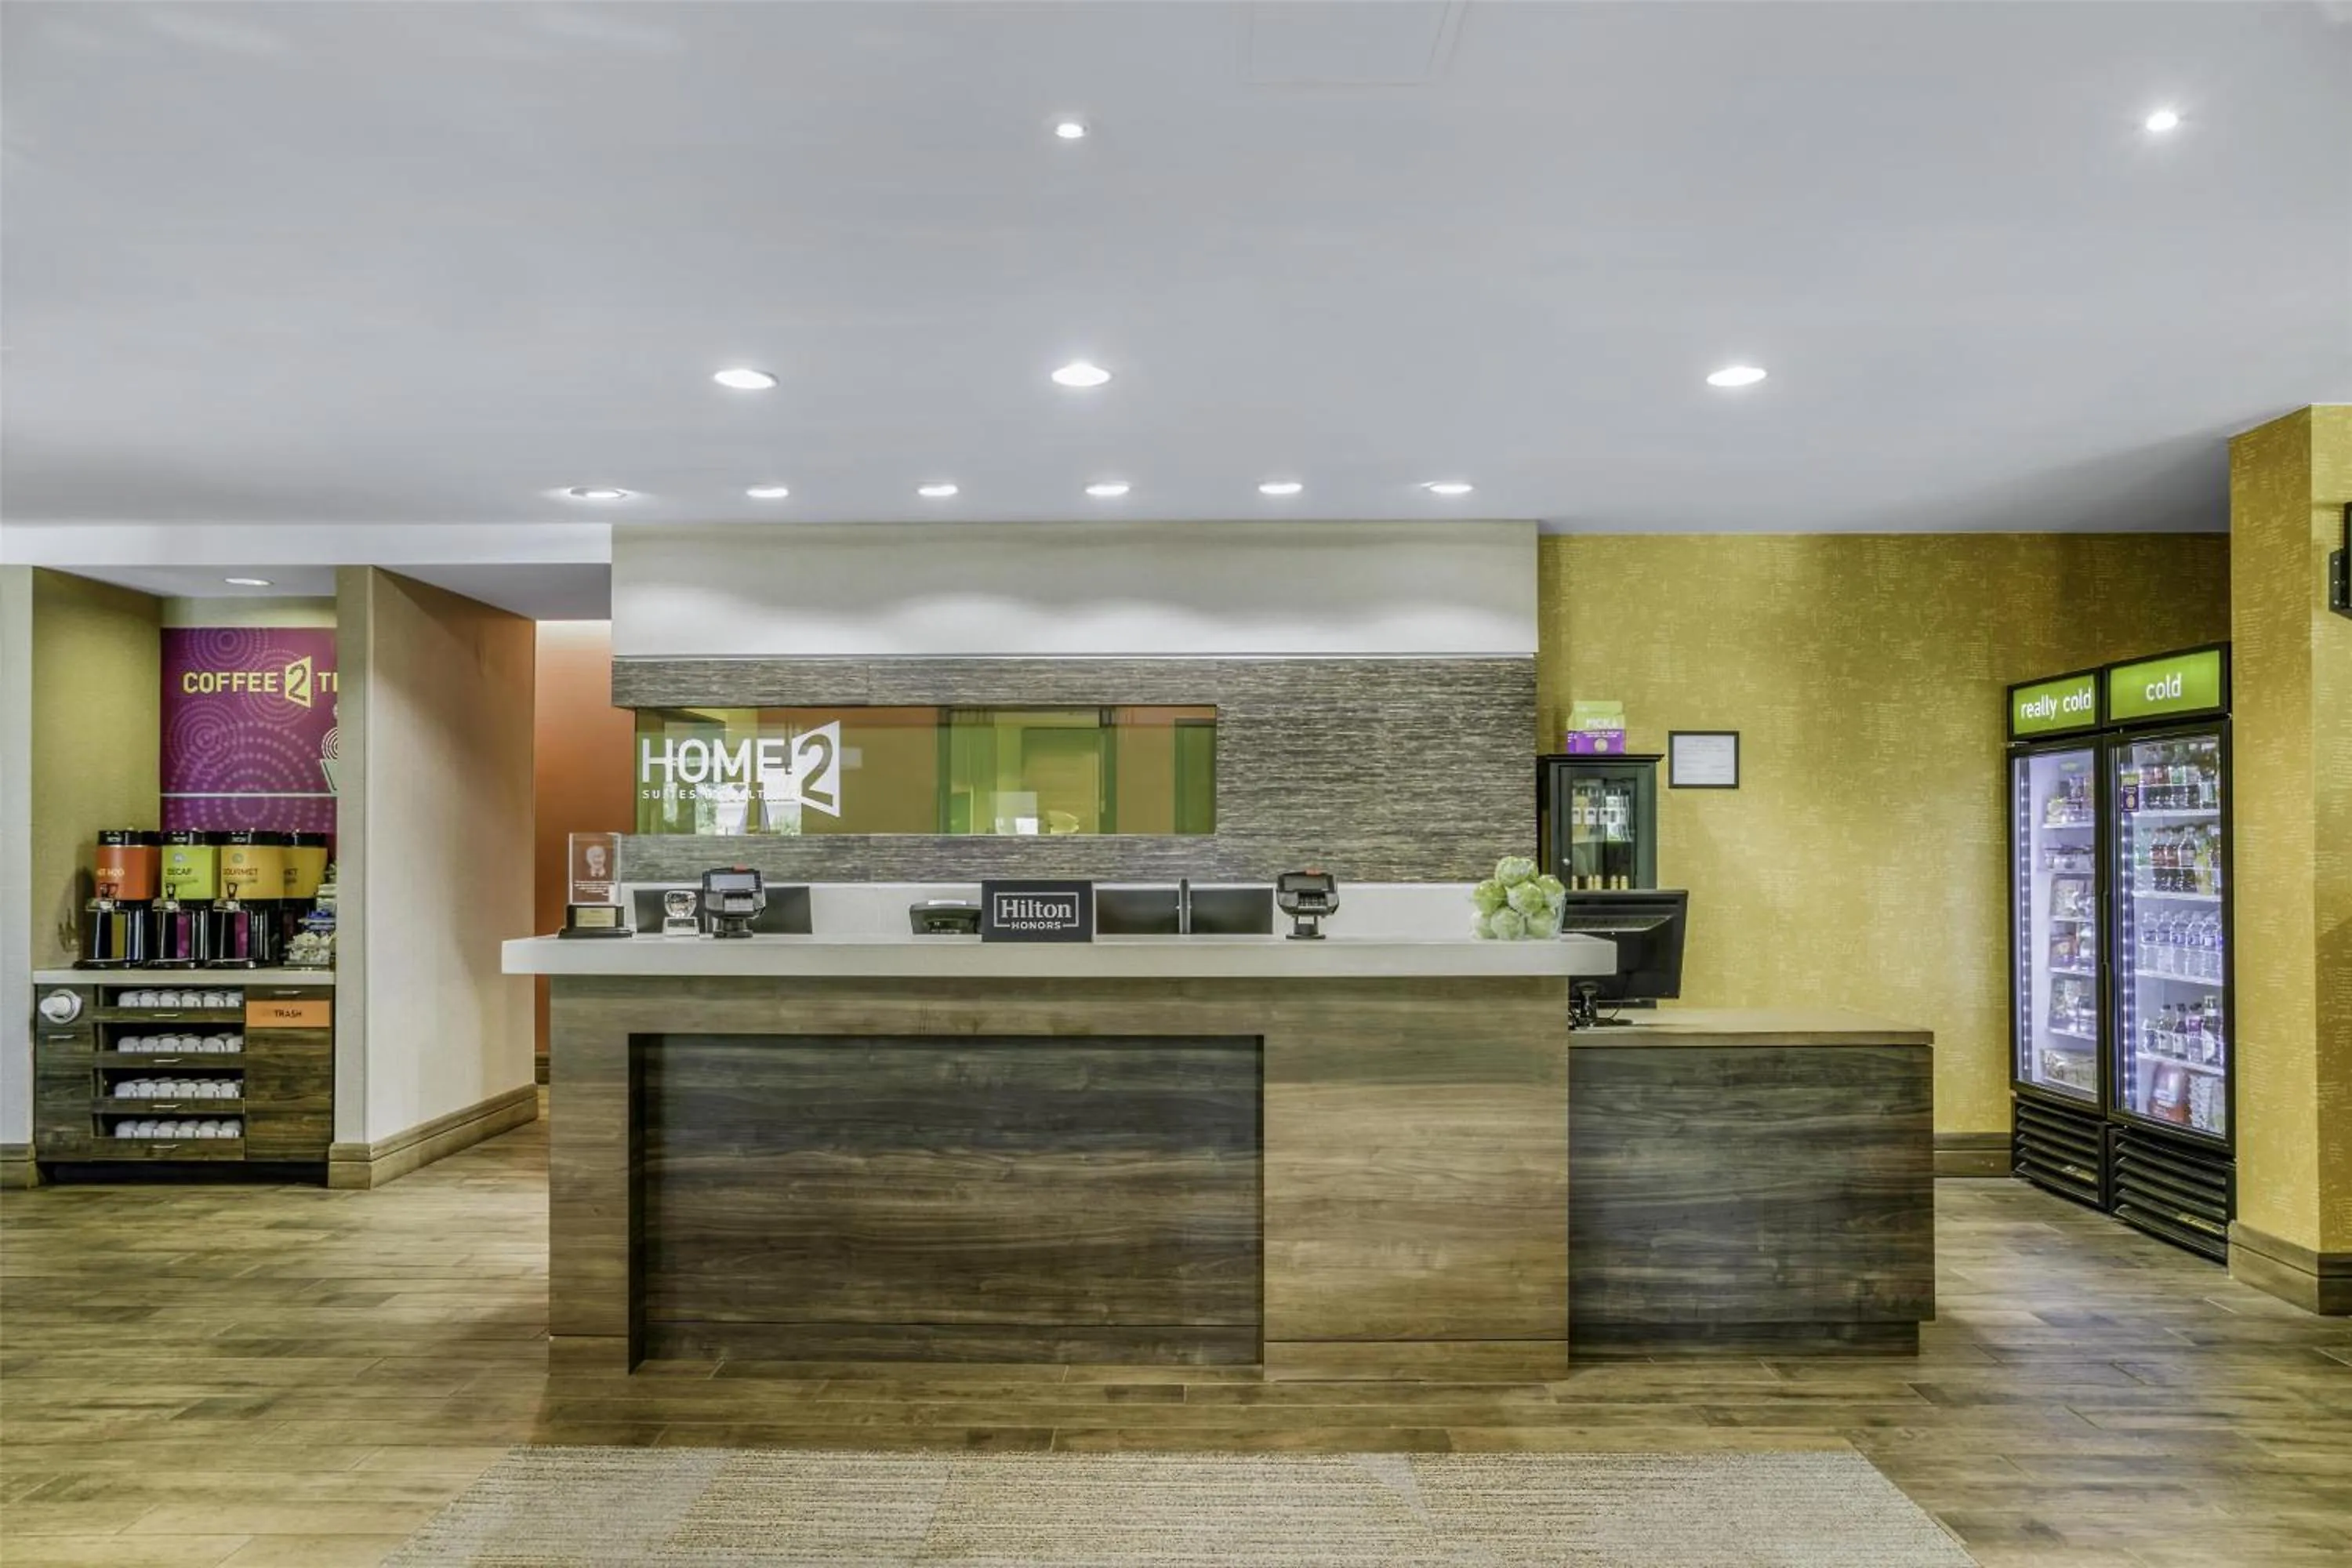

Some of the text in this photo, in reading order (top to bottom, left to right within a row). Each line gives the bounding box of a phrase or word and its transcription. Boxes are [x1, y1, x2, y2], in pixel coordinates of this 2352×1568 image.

[183, 671, 278, 693] COFFEE
[286, 661, 310, 703] 2
[2145, 672, 2183, 701] cold
[2020, 688, 2092, 720] really cold
[642, 789, 696, 800] SUES
[1000, 898, 1072, 919] Hilton
[1011, 921, 1061, 930] HONORS
[274, 1009, 303, 1018] TRASH
